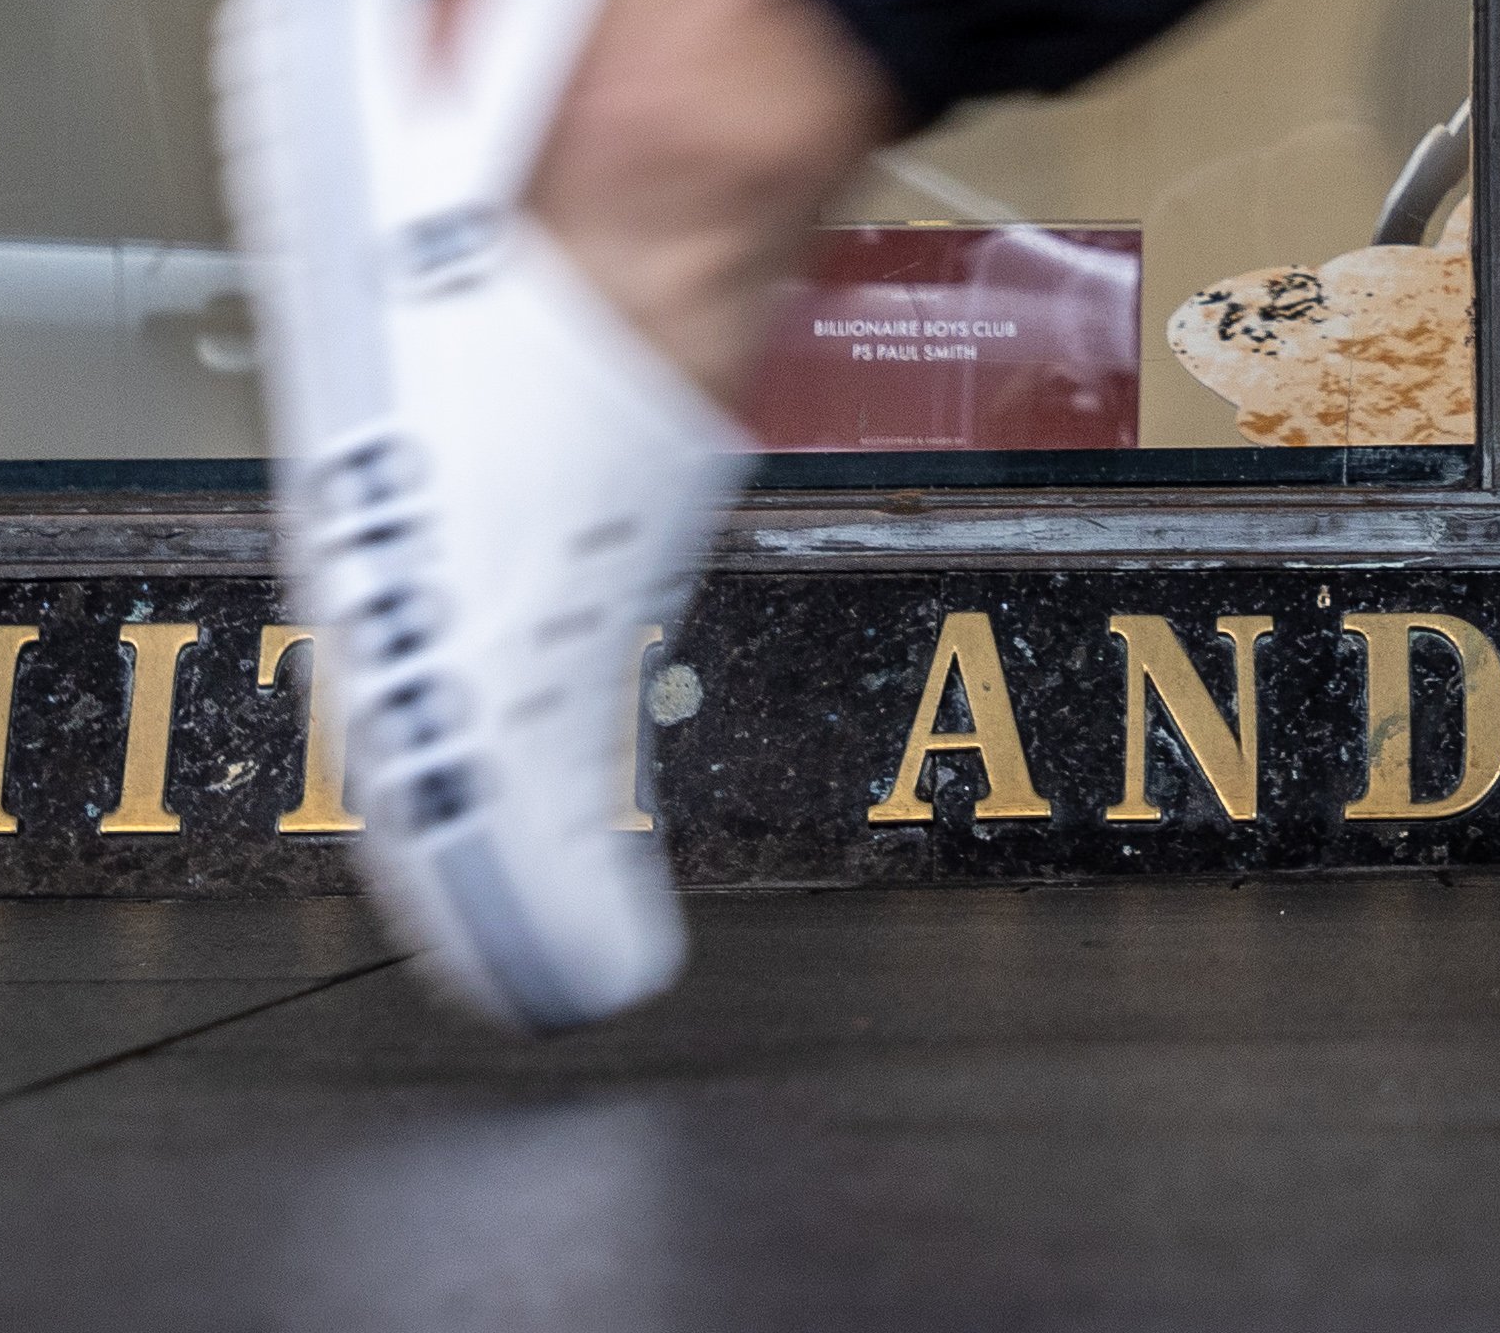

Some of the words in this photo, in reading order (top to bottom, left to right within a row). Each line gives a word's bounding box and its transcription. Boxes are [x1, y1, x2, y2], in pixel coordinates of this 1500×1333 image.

[814, 320, 919, 337] BILLIONAIRE
[923, 321, 970, 337] BOYS
[972, 321, 1017, 337] CLUB
[853, 344, 872, 360] PS
[876, 344, 919, 361] PAUL
[923, 344, 977, 361] SMITH
